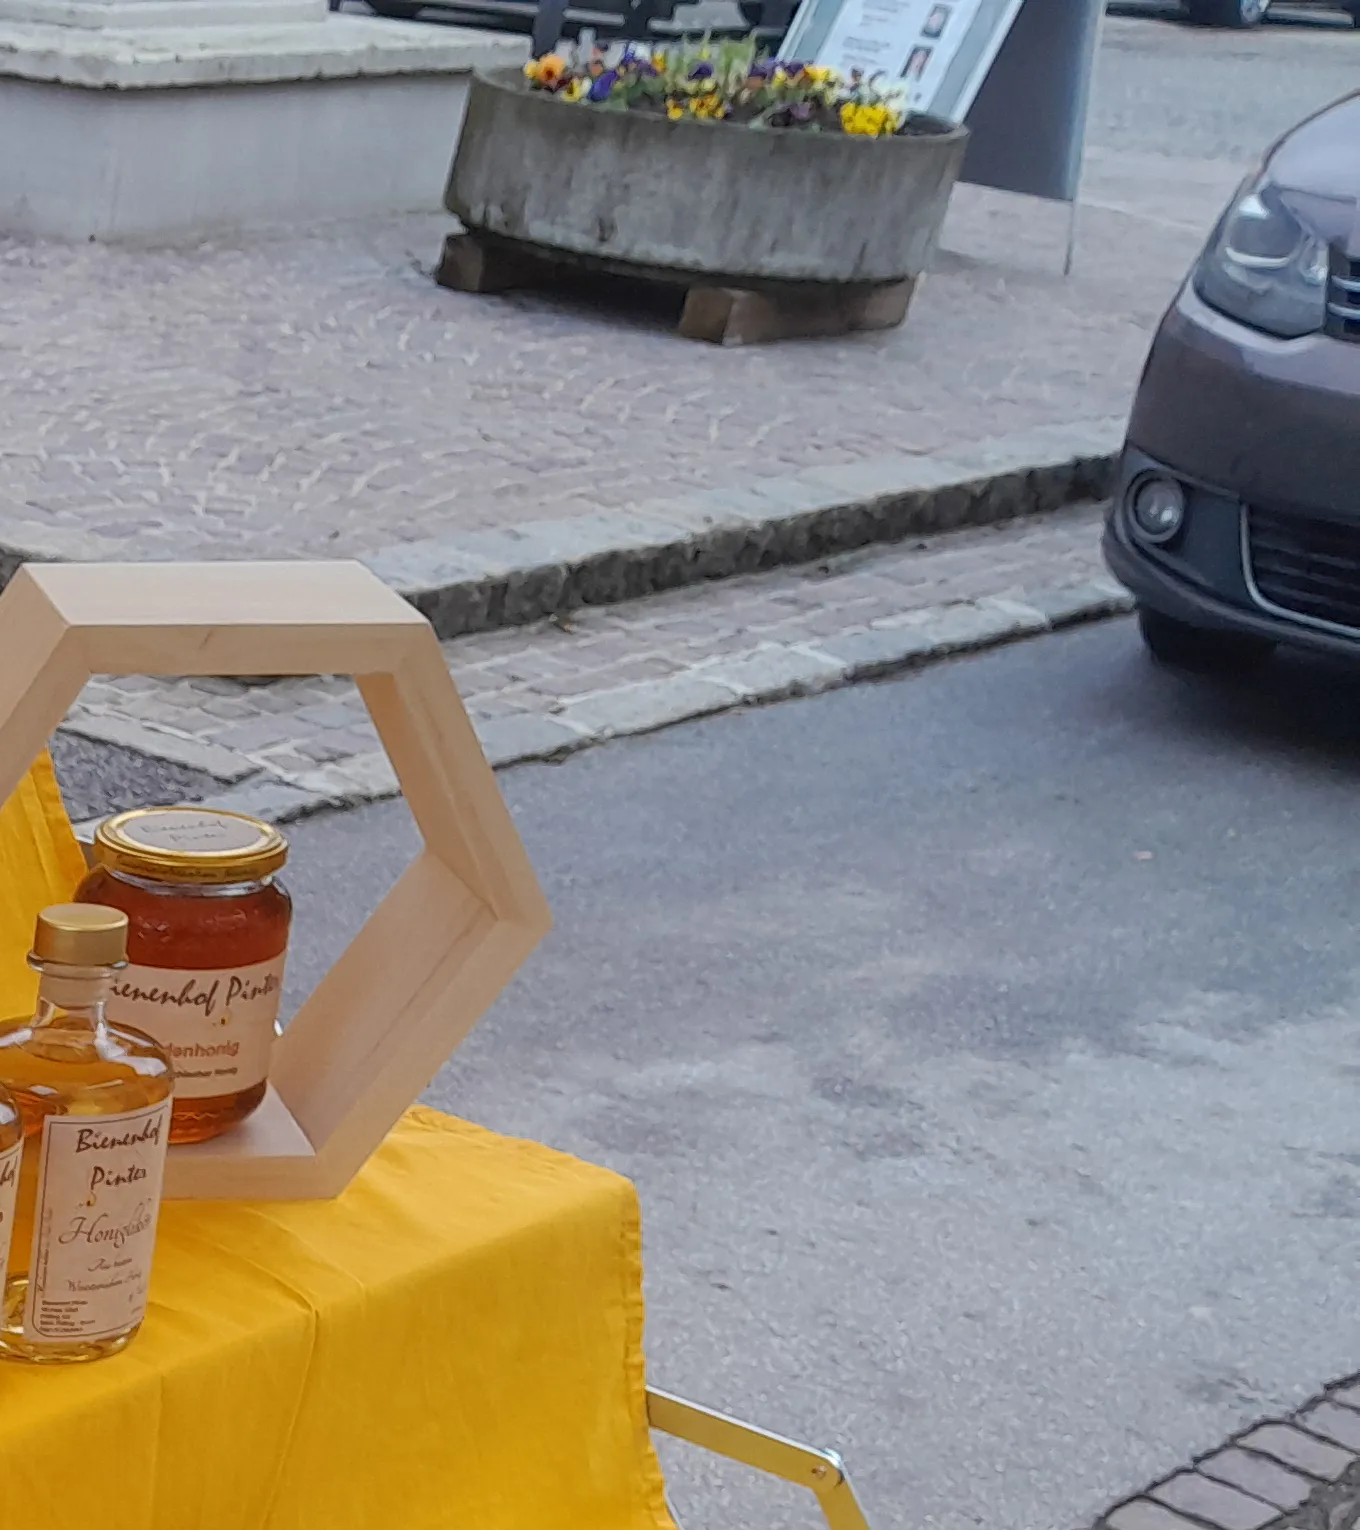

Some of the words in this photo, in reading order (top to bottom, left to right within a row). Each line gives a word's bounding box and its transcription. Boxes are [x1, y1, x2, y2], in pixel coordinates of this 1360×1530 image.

[111, 980, 219, 1016] ienenhof
[76, 1114, 162, 1153] Bienenhof
[90, 1164, 147, 1190] Pinter
